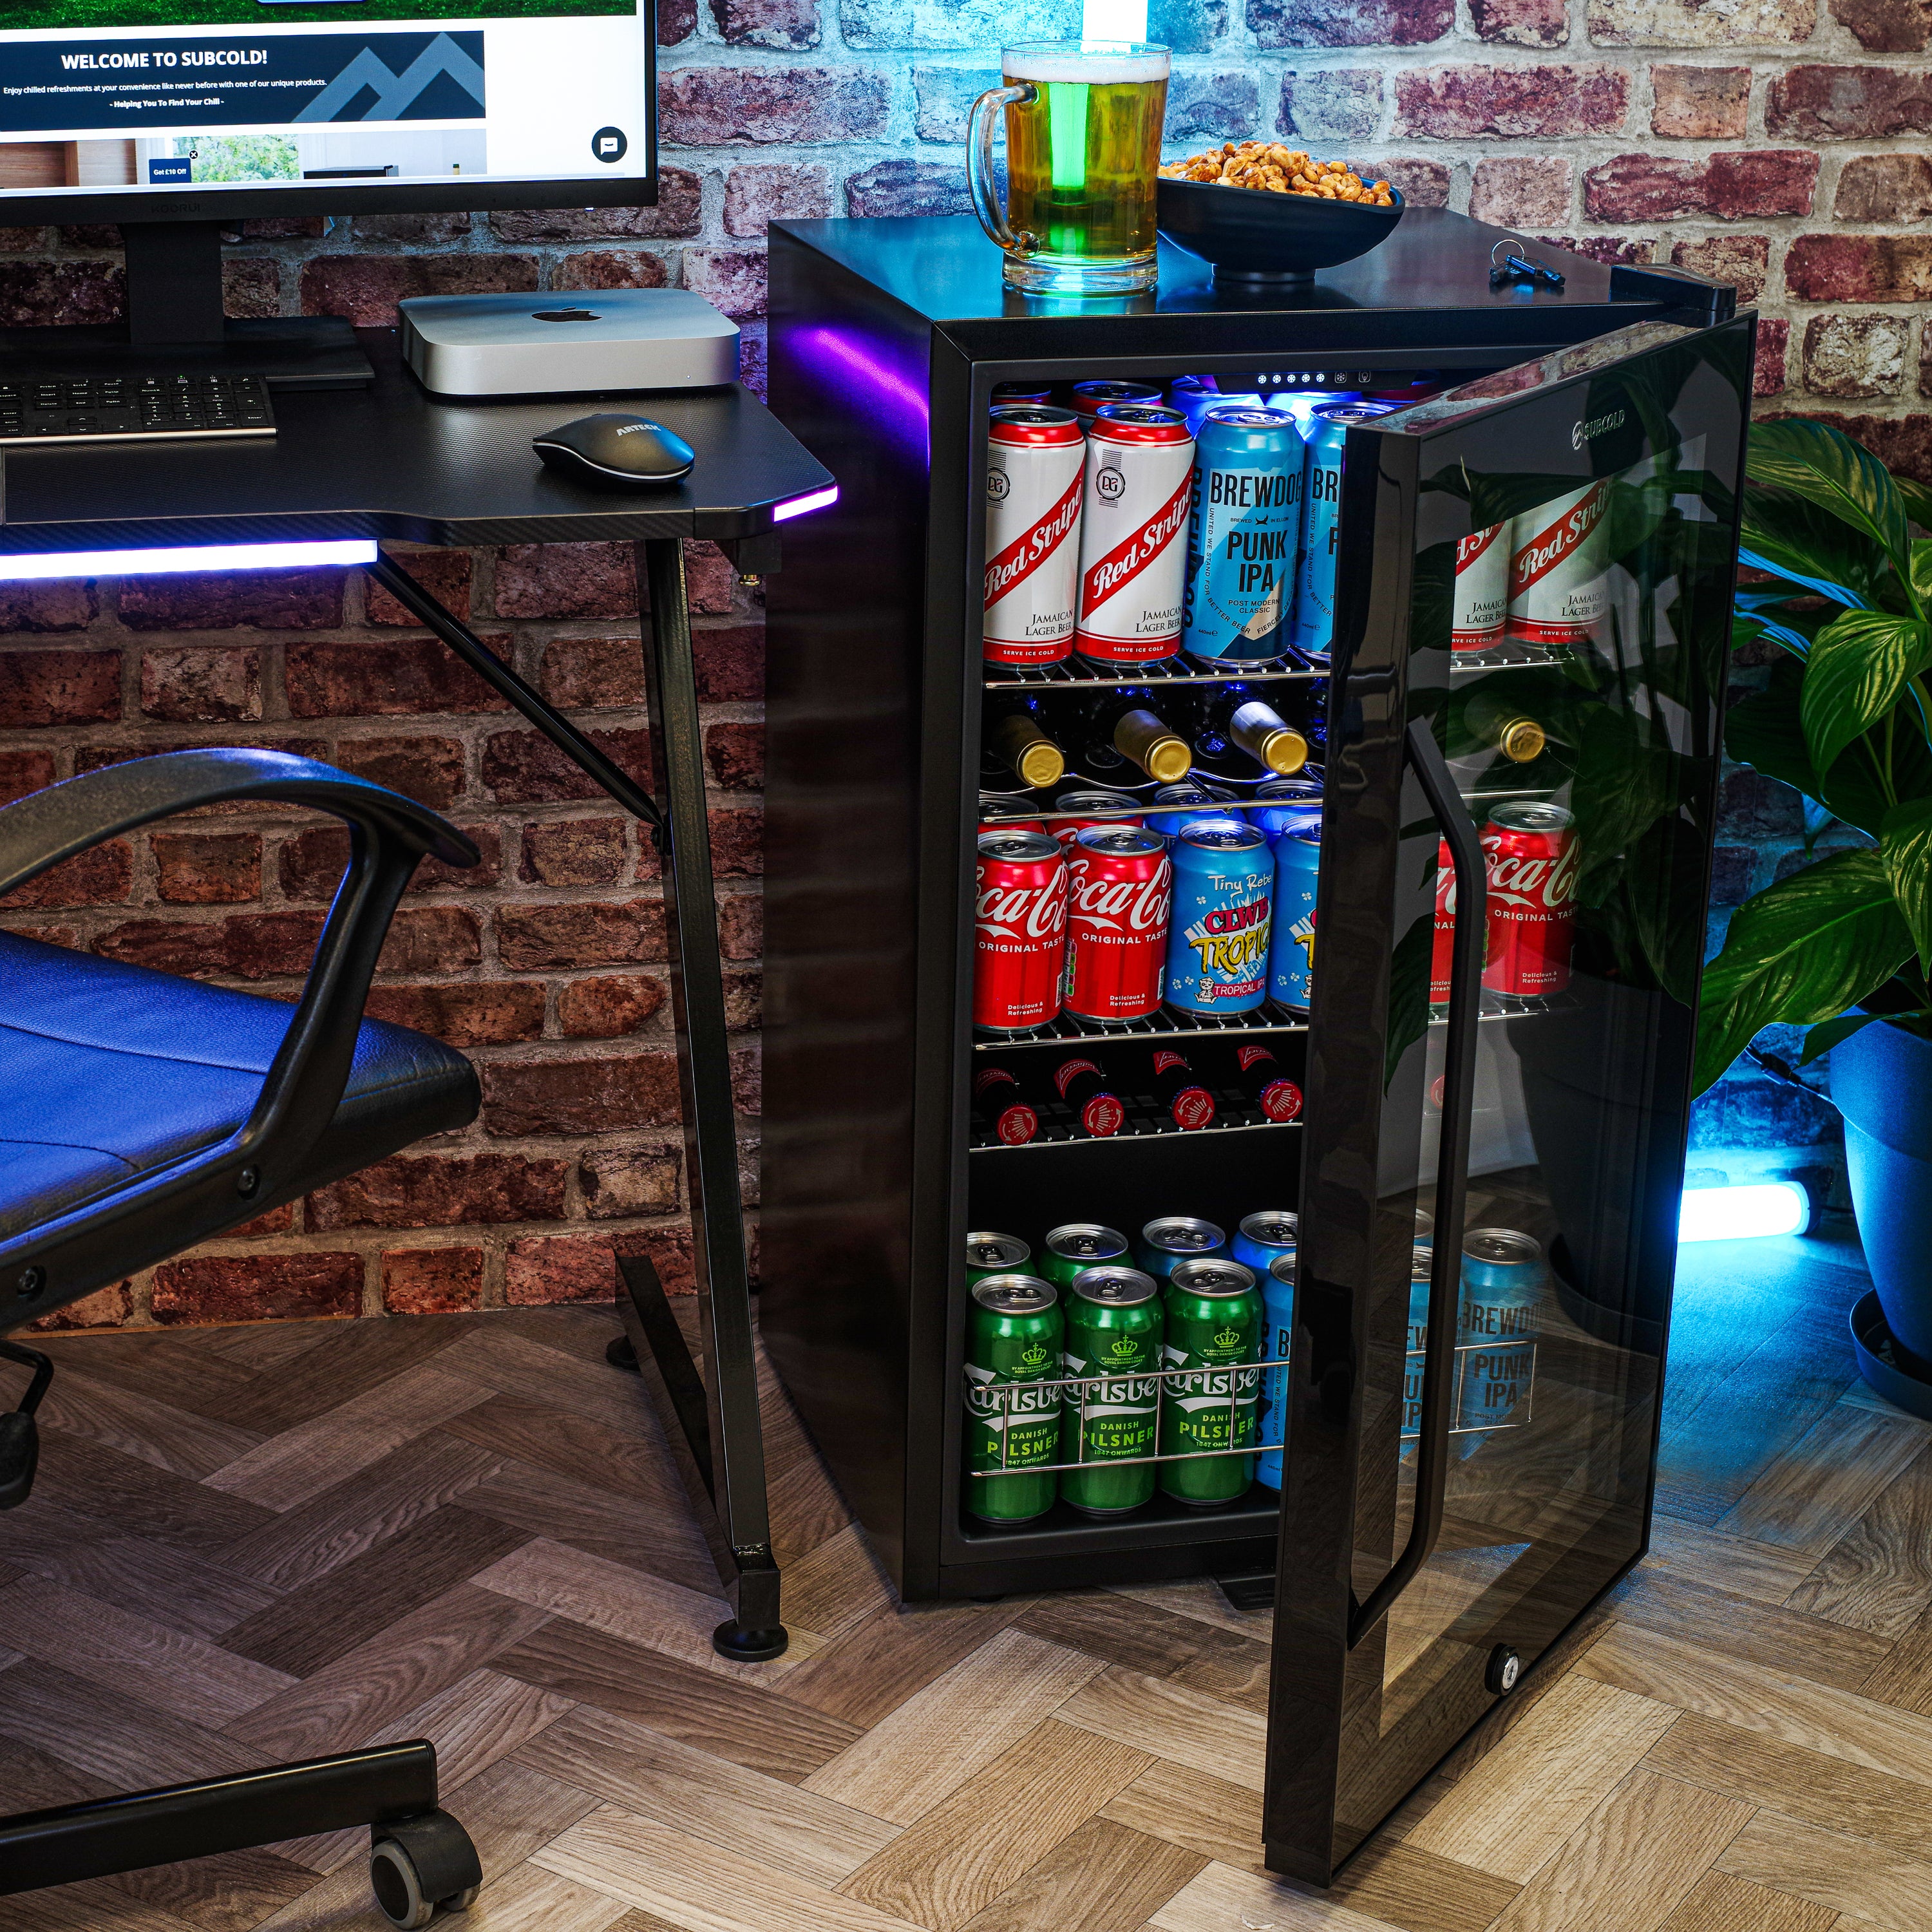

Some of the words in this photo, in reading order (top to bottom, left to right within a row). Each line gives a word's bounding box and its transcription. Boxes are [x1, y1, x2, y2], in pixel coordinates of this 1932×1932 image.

[61, 53, 149, 69] WELCOME
[153, 52, 177, 67] TO
[181, 50, 267, 66] SUBCOLD!
[3, 87, 23, 95] Enjoy
[47, 84, 92, 93] refreshments
[102, 85, 117, 93] your
[270, 80, 294, 88] unique
[296, 79, 327, 87] products.
[114, 100, 142, 109] Helping
[616, 424, 661, 437] ARTECK
[1584, 410, 1625, 440] SUBCOLD
[1210, 471, 1302, 508] BREWDOG
[985, 545, 1028, 601] Red
[1028, 483, 1081, 562] Stripe
[1093, 543, 1139, 599] Red
[1140, 481, 1191, 558] Stripe
[1207, 538, 1213, 549] WE
[1227, 530, 1288, 561] PUNK
[1309, 533, 1315, 544] WE
[1519, 529, 1565, 583] Red
[1238, 563, 1274, 592] IPA
[1208, 598, 1230, 622] BETTER
[1311, 592, 1332, 617] BETTER
[1231, 620, 1251, 634] BEER
[1257, 611, 1283, 634] FIERCELY
[1208, 875, 1244, 902] Tiny
[1204, 896, 1269, 934] CLWB
[1495, 909, 1553, 921] ORIGINAL
[979, 942, 1038, 952] ORIGINAL
[1043, 934, 1065, 950] TASTE
[1082, 933, 1141, 944] ORIGINAL
[1145, 928, 1168, 942] TASTE
[1189, 922, 1270, 975] TROPIC
[1214, 983, 1255, 995] TROPICAL
[1110, 999, 1145, 1007] Refreshing
[1474, 1354, 1532, 1381] PUNK
[1274, 1386, 1281, 1397] WE
[1485, 1382, 1517, 1408] IPA
[1101, 1421, 1139, 1430] DANISH
[1202, 1412, 1240, 1422] DANIH
[1011, 1427, 1047, 1439] DANISH
[1213, 1437, 1242, 1447] ONWRDS
[987, 1431, 1058, 1456] PLSNER
[1111, 1446, 1142, 1456] ONWARDS
[1021, 1453, 1049, 1465] ONWARDS
